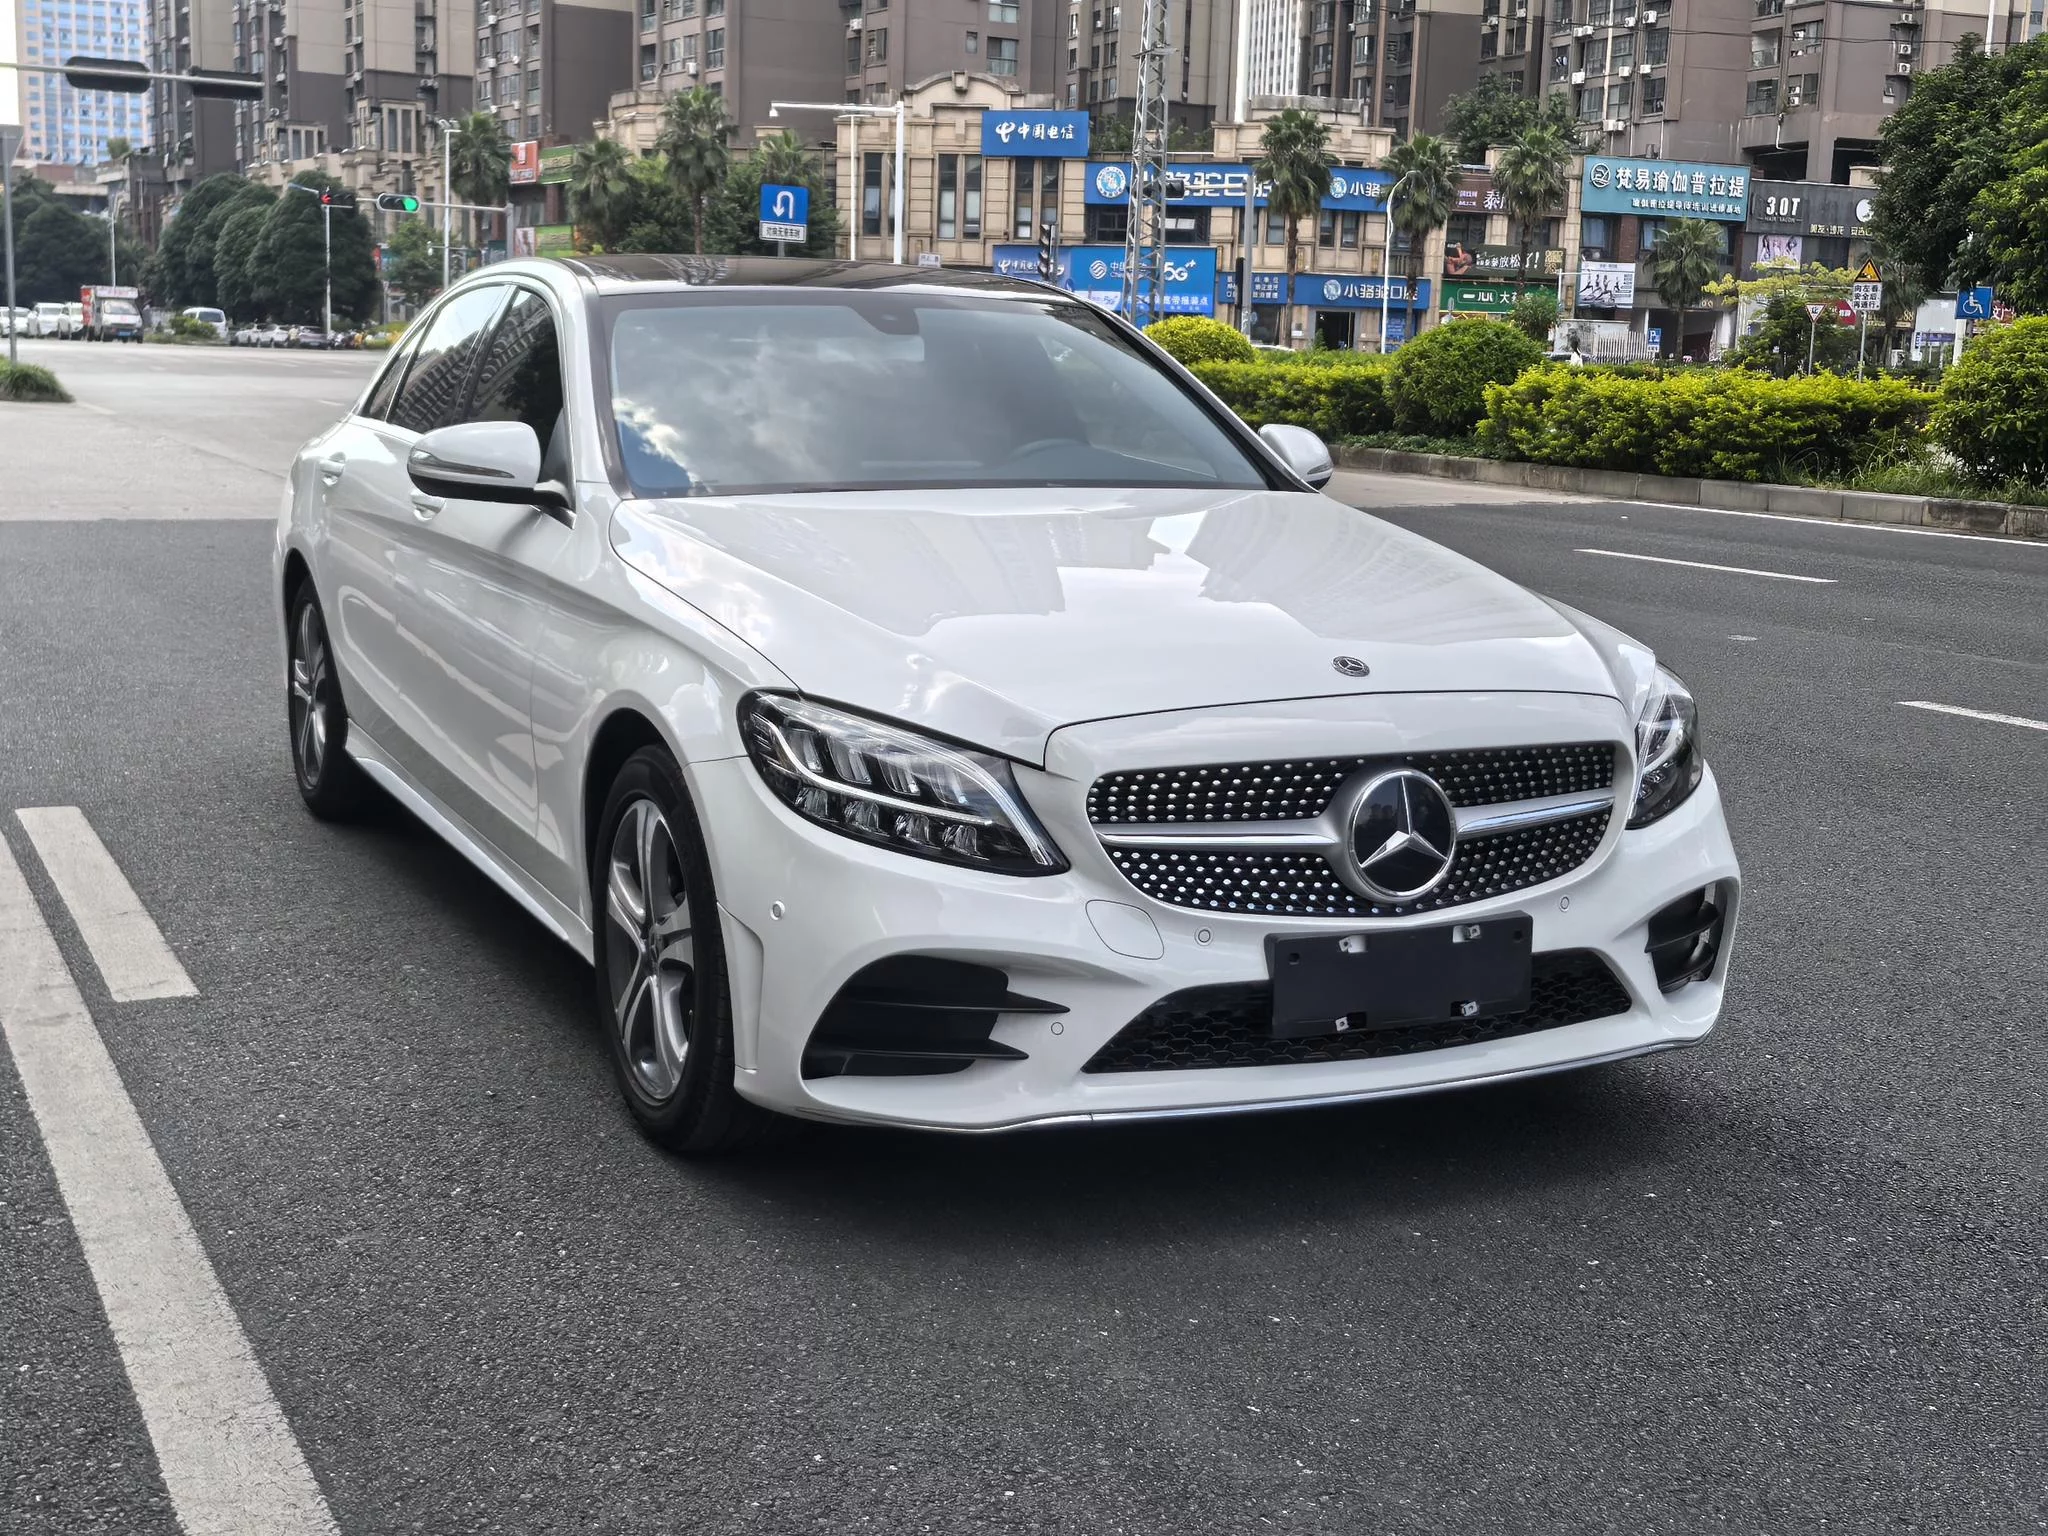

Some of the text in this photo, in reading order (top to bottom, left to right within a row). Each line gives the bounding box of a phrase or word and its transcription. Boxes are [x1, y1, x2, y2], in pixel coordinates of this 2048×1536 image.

[1017, 121, 1075, 140] 中国电信
[1350, 181, 1384, 197] 小骆
[1615, 167, 1745, 198] 梵易瑜伽普拉提
